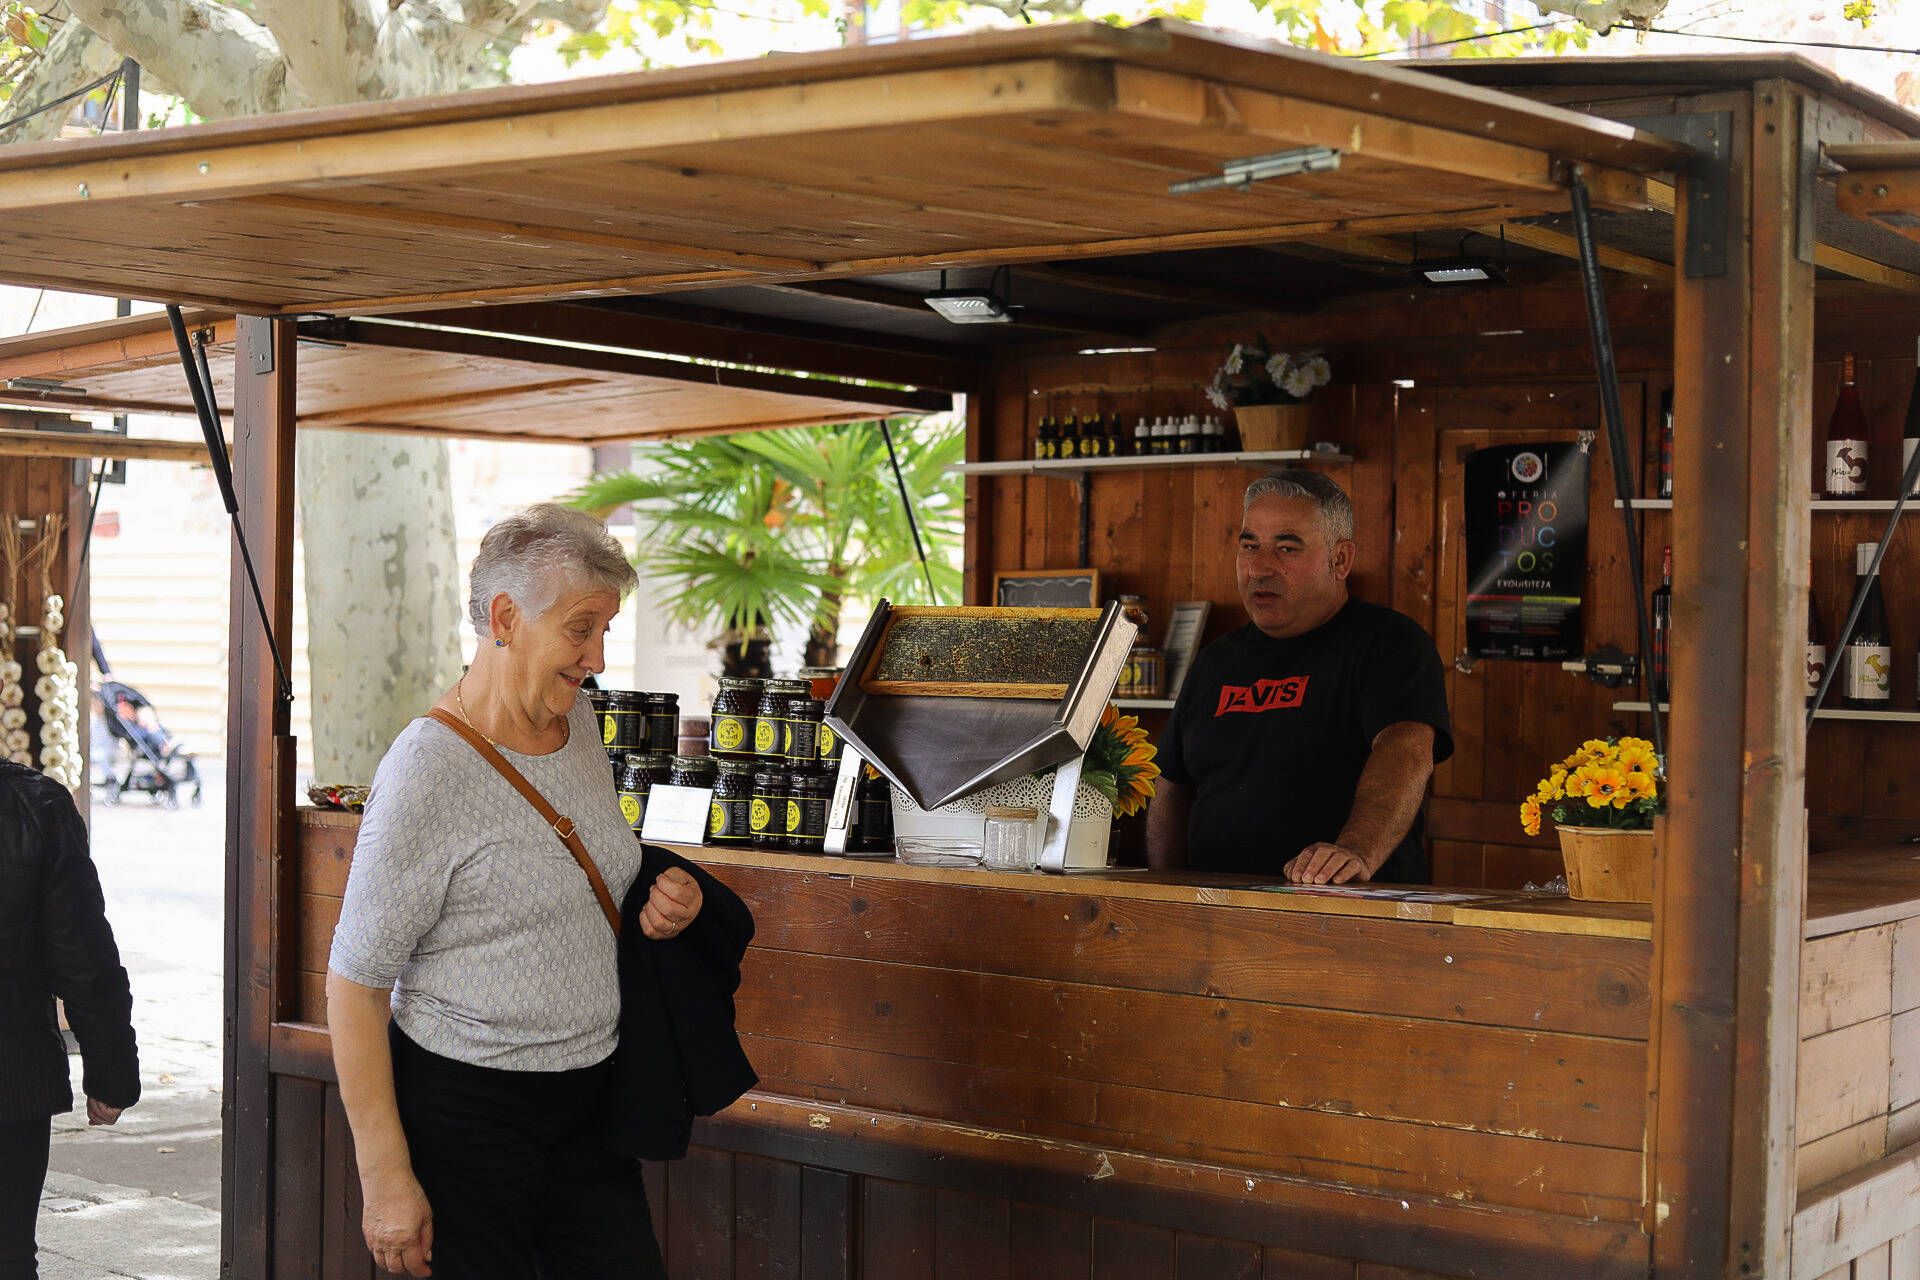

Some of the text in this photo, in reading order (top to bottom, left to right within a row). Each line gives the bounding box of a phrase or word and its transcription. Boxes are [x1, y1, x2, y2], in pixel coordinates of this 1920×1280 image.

[1497, 500, 1557, 522] PRO
[1498, 526, 1556, 548] DUC
[1498, 550, 1553, 573] TOS
